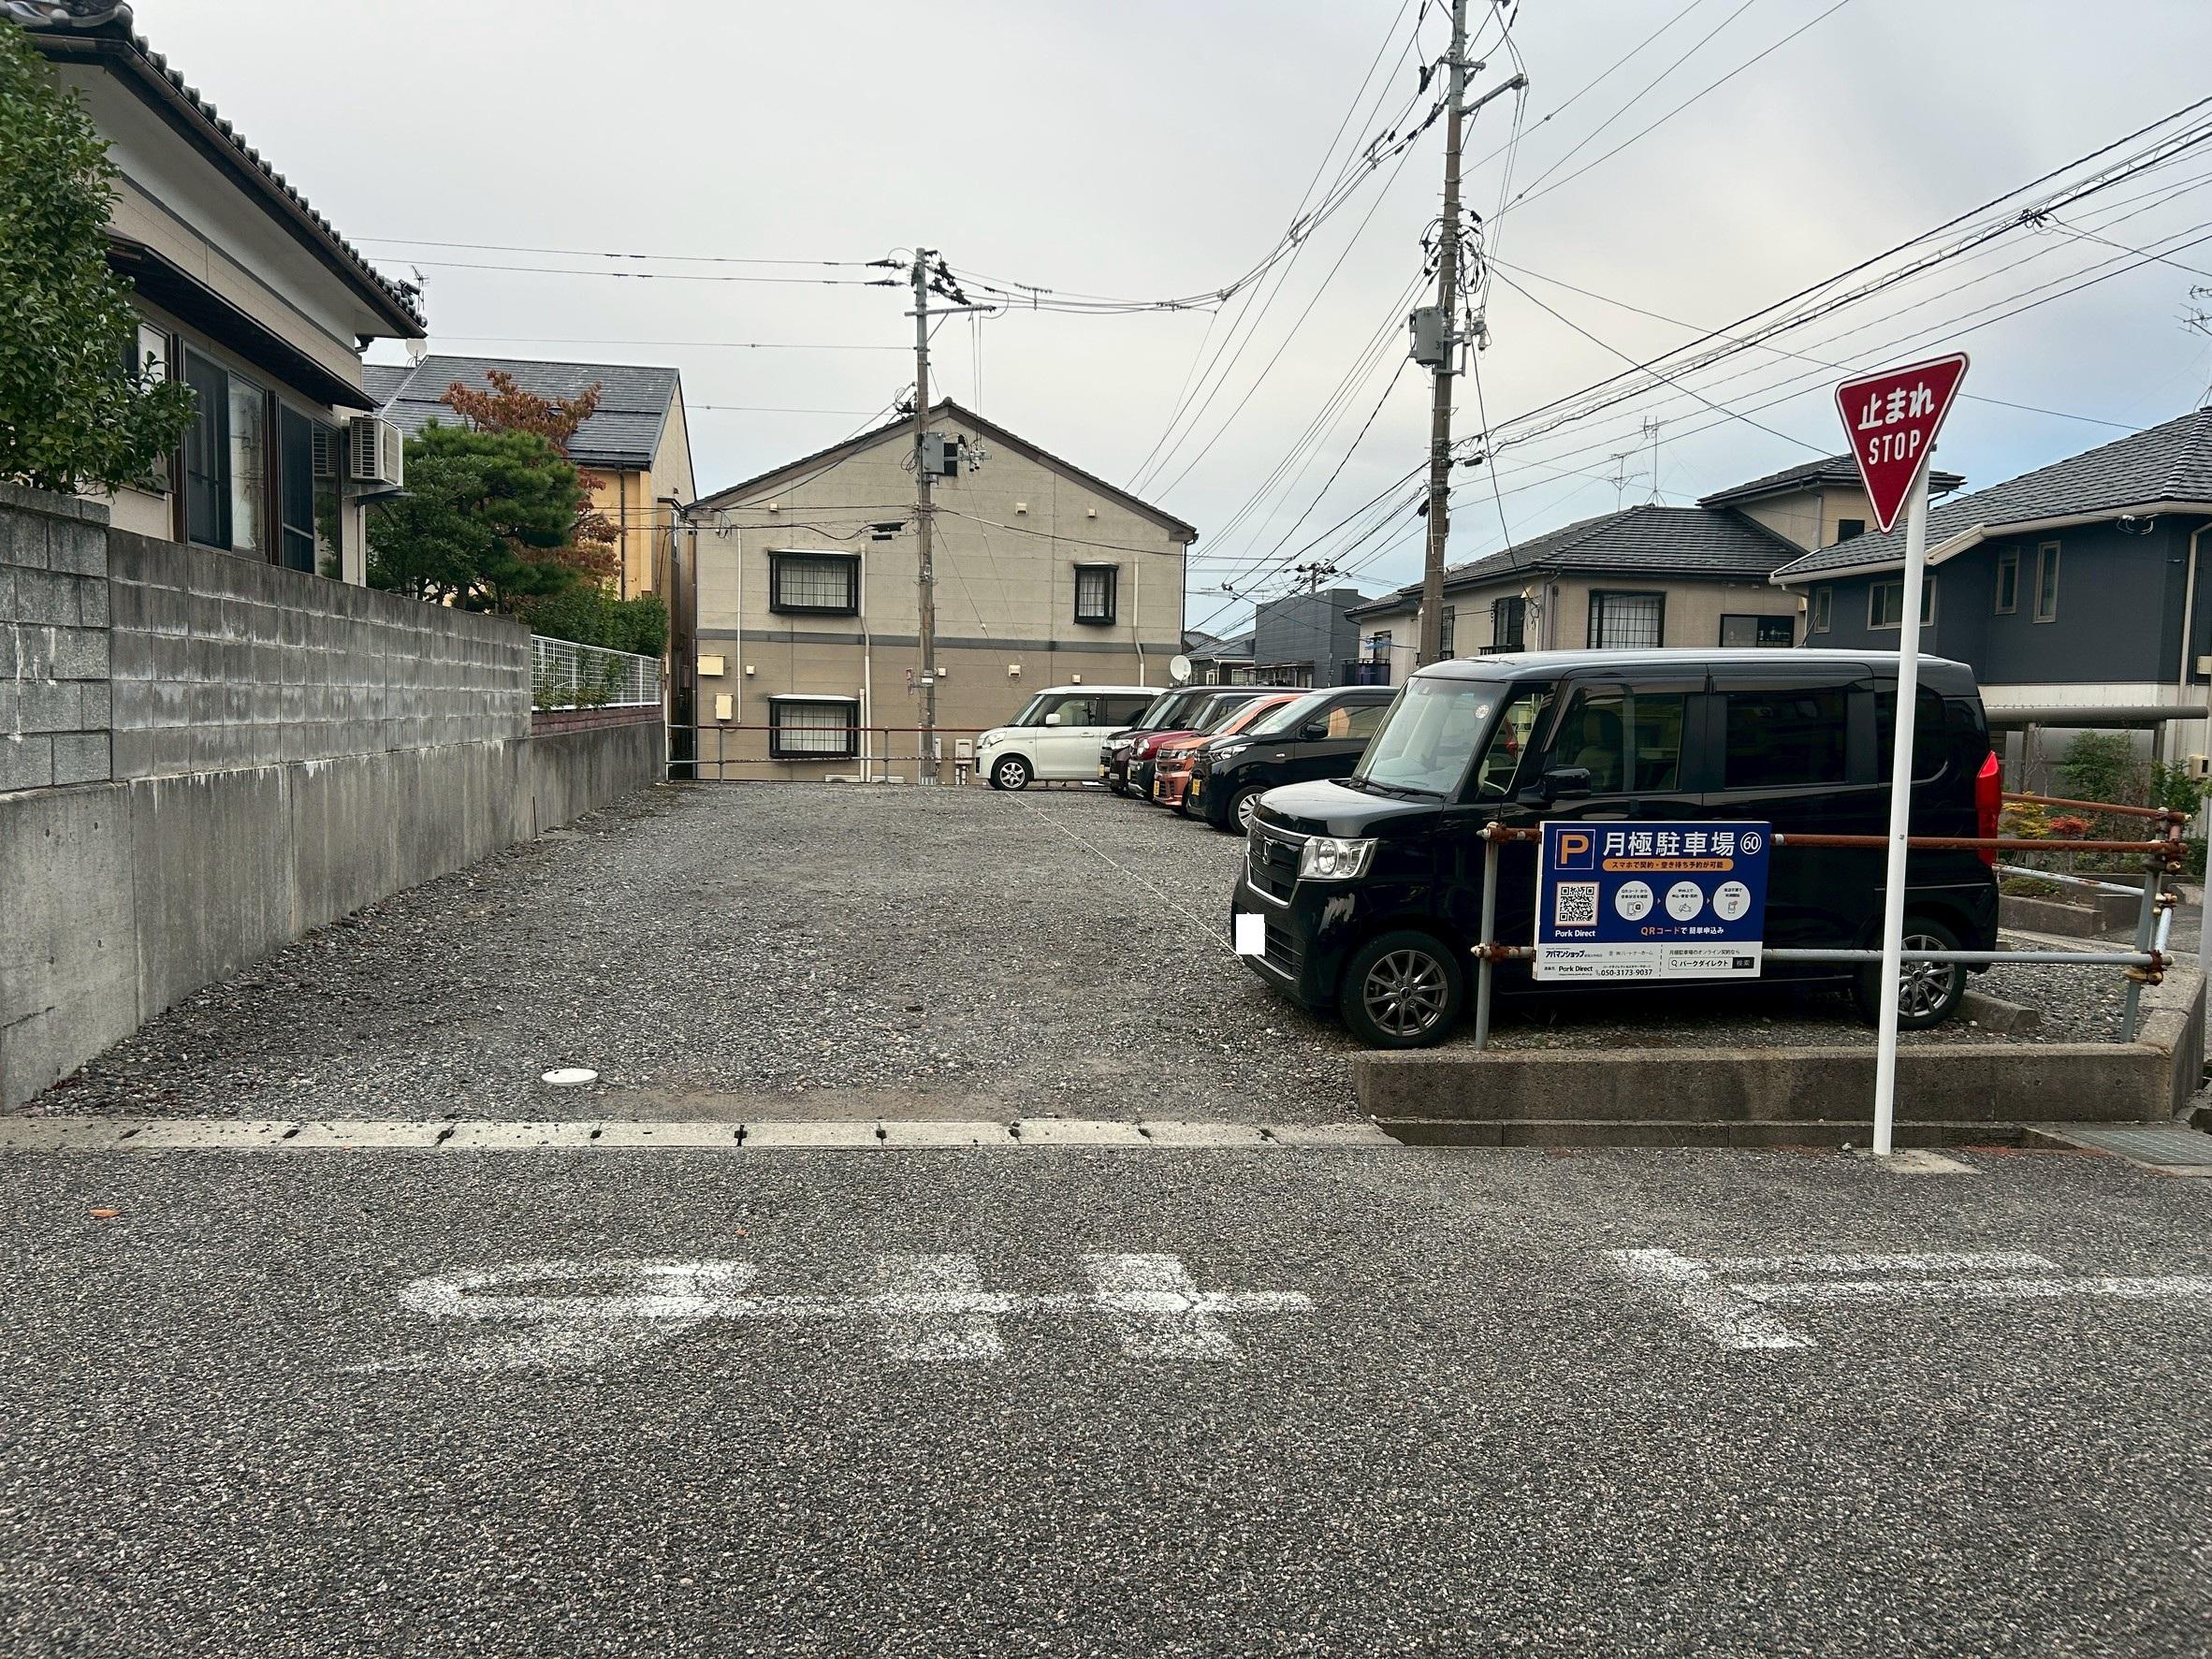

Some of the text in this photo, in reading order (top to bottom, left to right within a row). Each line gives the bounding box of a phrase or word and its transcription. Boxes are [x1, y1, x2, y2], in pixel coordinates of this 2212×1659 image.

[1857, 382, 1935, 430] 止まれ
[1868, 429, 1921, 465] STOP
[1561, 835, 1589, 865] P
[1603, 831, 1736, 857] 月極駐車場
[1575, 929, 1596, 938] Direct
[1546, 950, 1586, 958] アパマンショップ
[1601, 968, 1653, 977] 050-3173-9037
